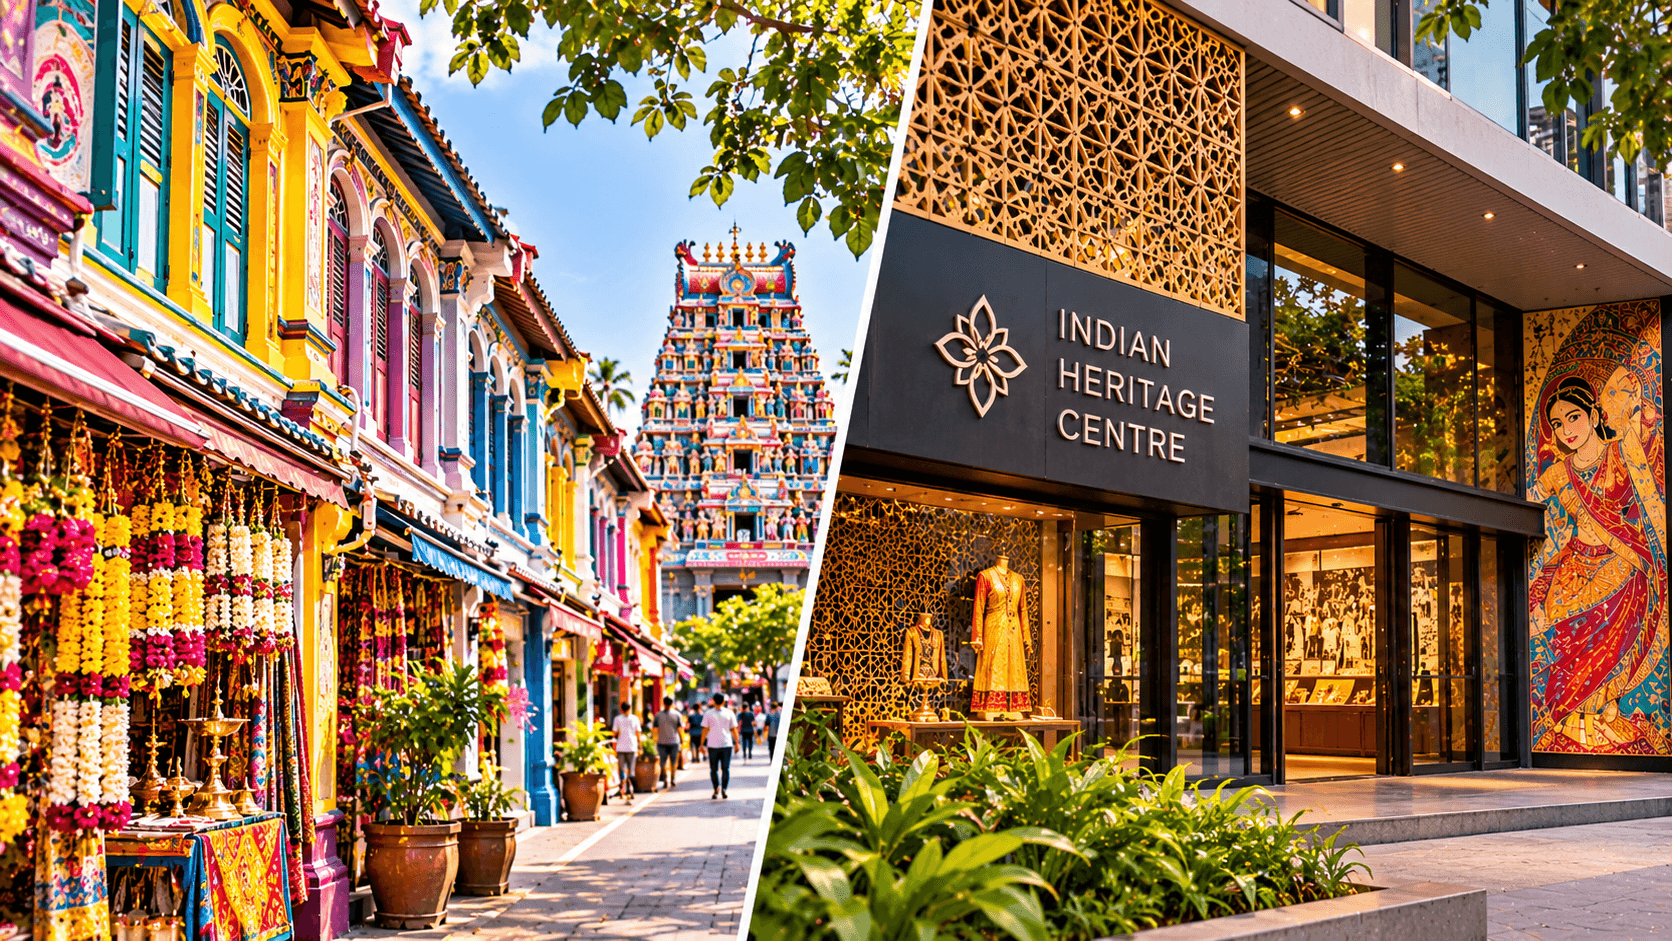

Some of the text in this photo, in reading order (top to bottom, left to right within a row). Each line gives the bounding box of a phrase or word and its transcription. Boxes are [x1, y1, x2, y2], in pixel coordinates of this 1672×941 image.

[1058, 308, 1171, 368] INDIAN
[1058, 357, 1215, 424] HERITAGE
[1057, 408, 1186, 463] CENTRE
